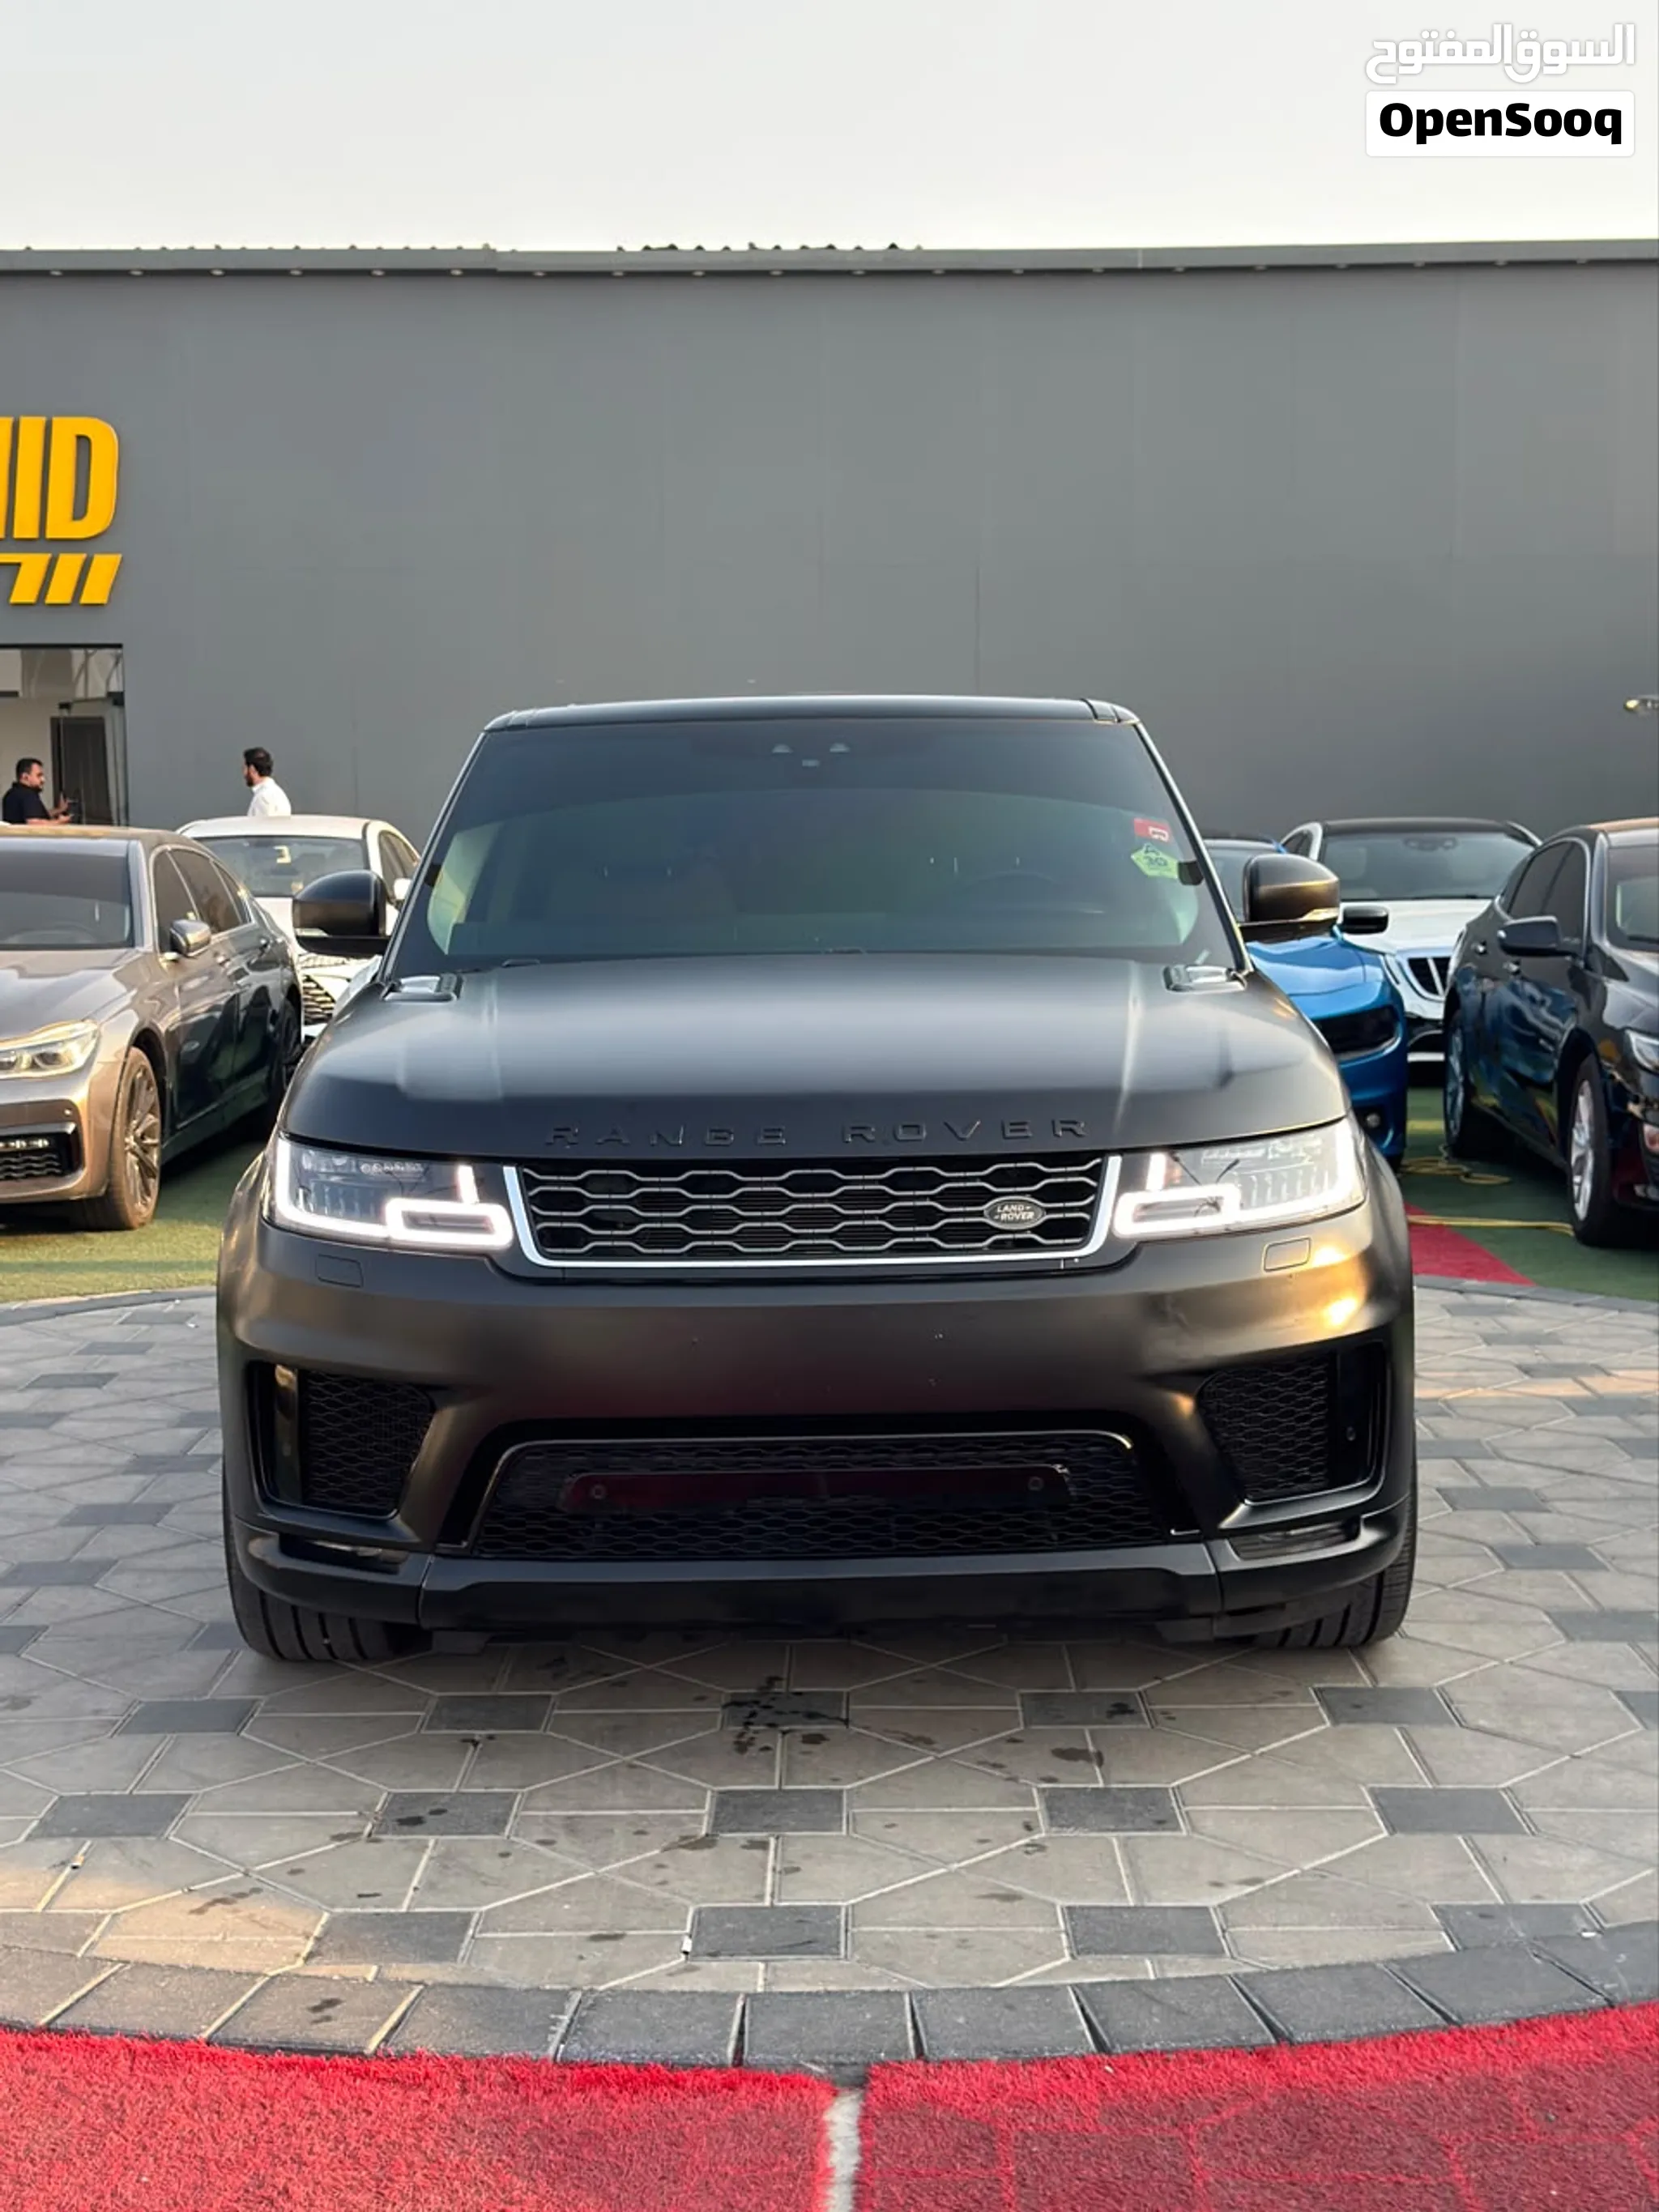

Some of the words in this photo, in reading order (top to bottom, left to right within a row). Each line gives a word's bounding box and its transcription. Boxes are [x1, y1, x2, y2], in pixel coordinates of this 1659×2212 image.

[0, 416, 119, 540] ID
[545, 1126, 787, 1147] RANGE
[842, 1119, 1086, 1144] ROVER
[997, 1204, 1025, 1213] LAND
[1000, 1212, 1034, 1221] ROVER
